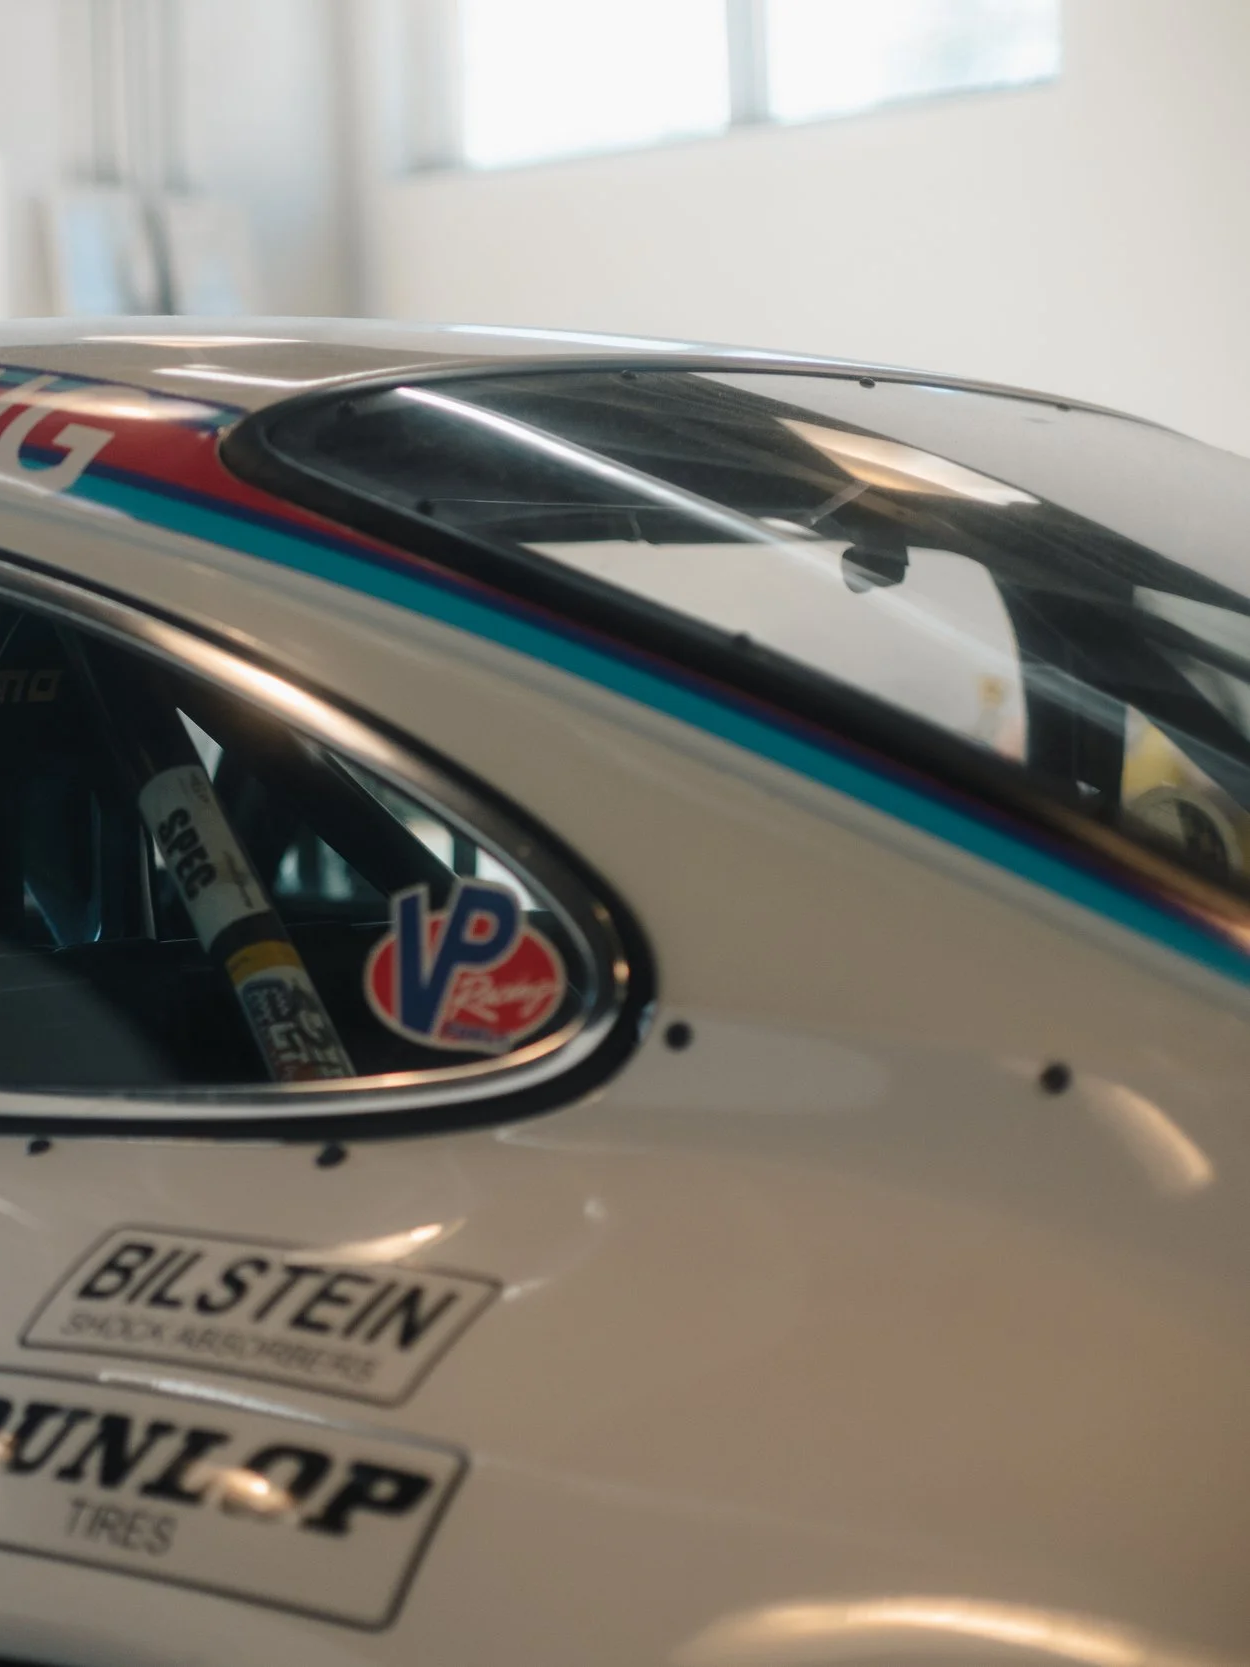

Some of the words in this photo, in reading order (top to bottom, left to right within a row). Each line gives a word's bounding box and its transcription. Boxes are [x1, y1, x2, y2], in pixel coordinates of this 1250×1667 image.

[158, 808, 218, 902] SPEC
[391, 880, 525, 1041] VP
[58, 1312, 170, 1346] SHOCK
[78, 1242, 460, 1352] BILSTEIN
[64, 1498, 178, 1556] TIRES
